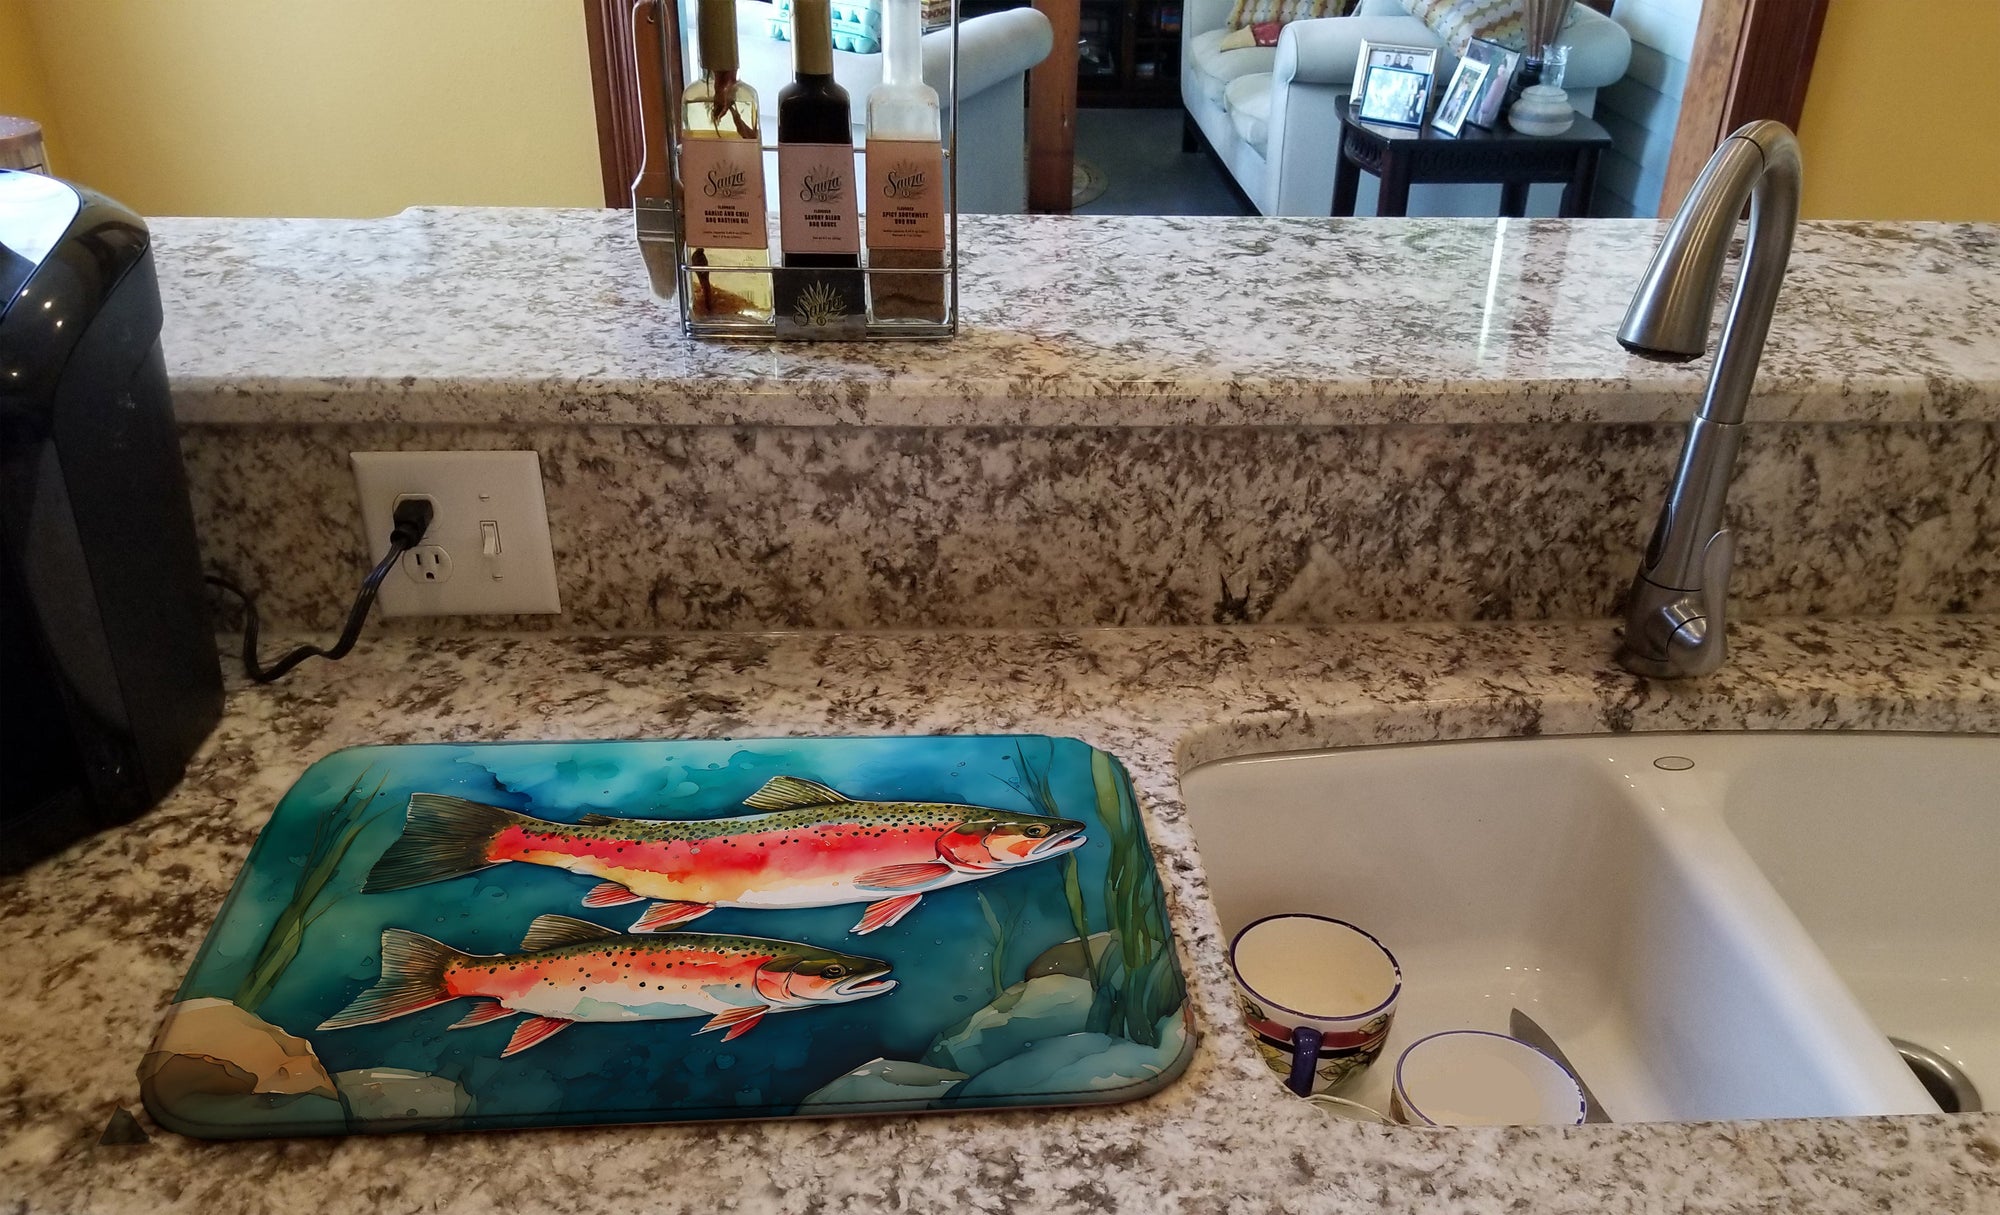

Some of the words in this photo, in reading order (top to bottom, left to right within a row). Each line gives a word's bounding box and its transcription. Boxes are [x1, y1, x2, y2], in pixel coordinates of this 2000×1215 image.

[704, 170, 745, 197] Sauza
[800, 175, 841, 202] Sauza
[884, 170, 925, 198] Sauza
